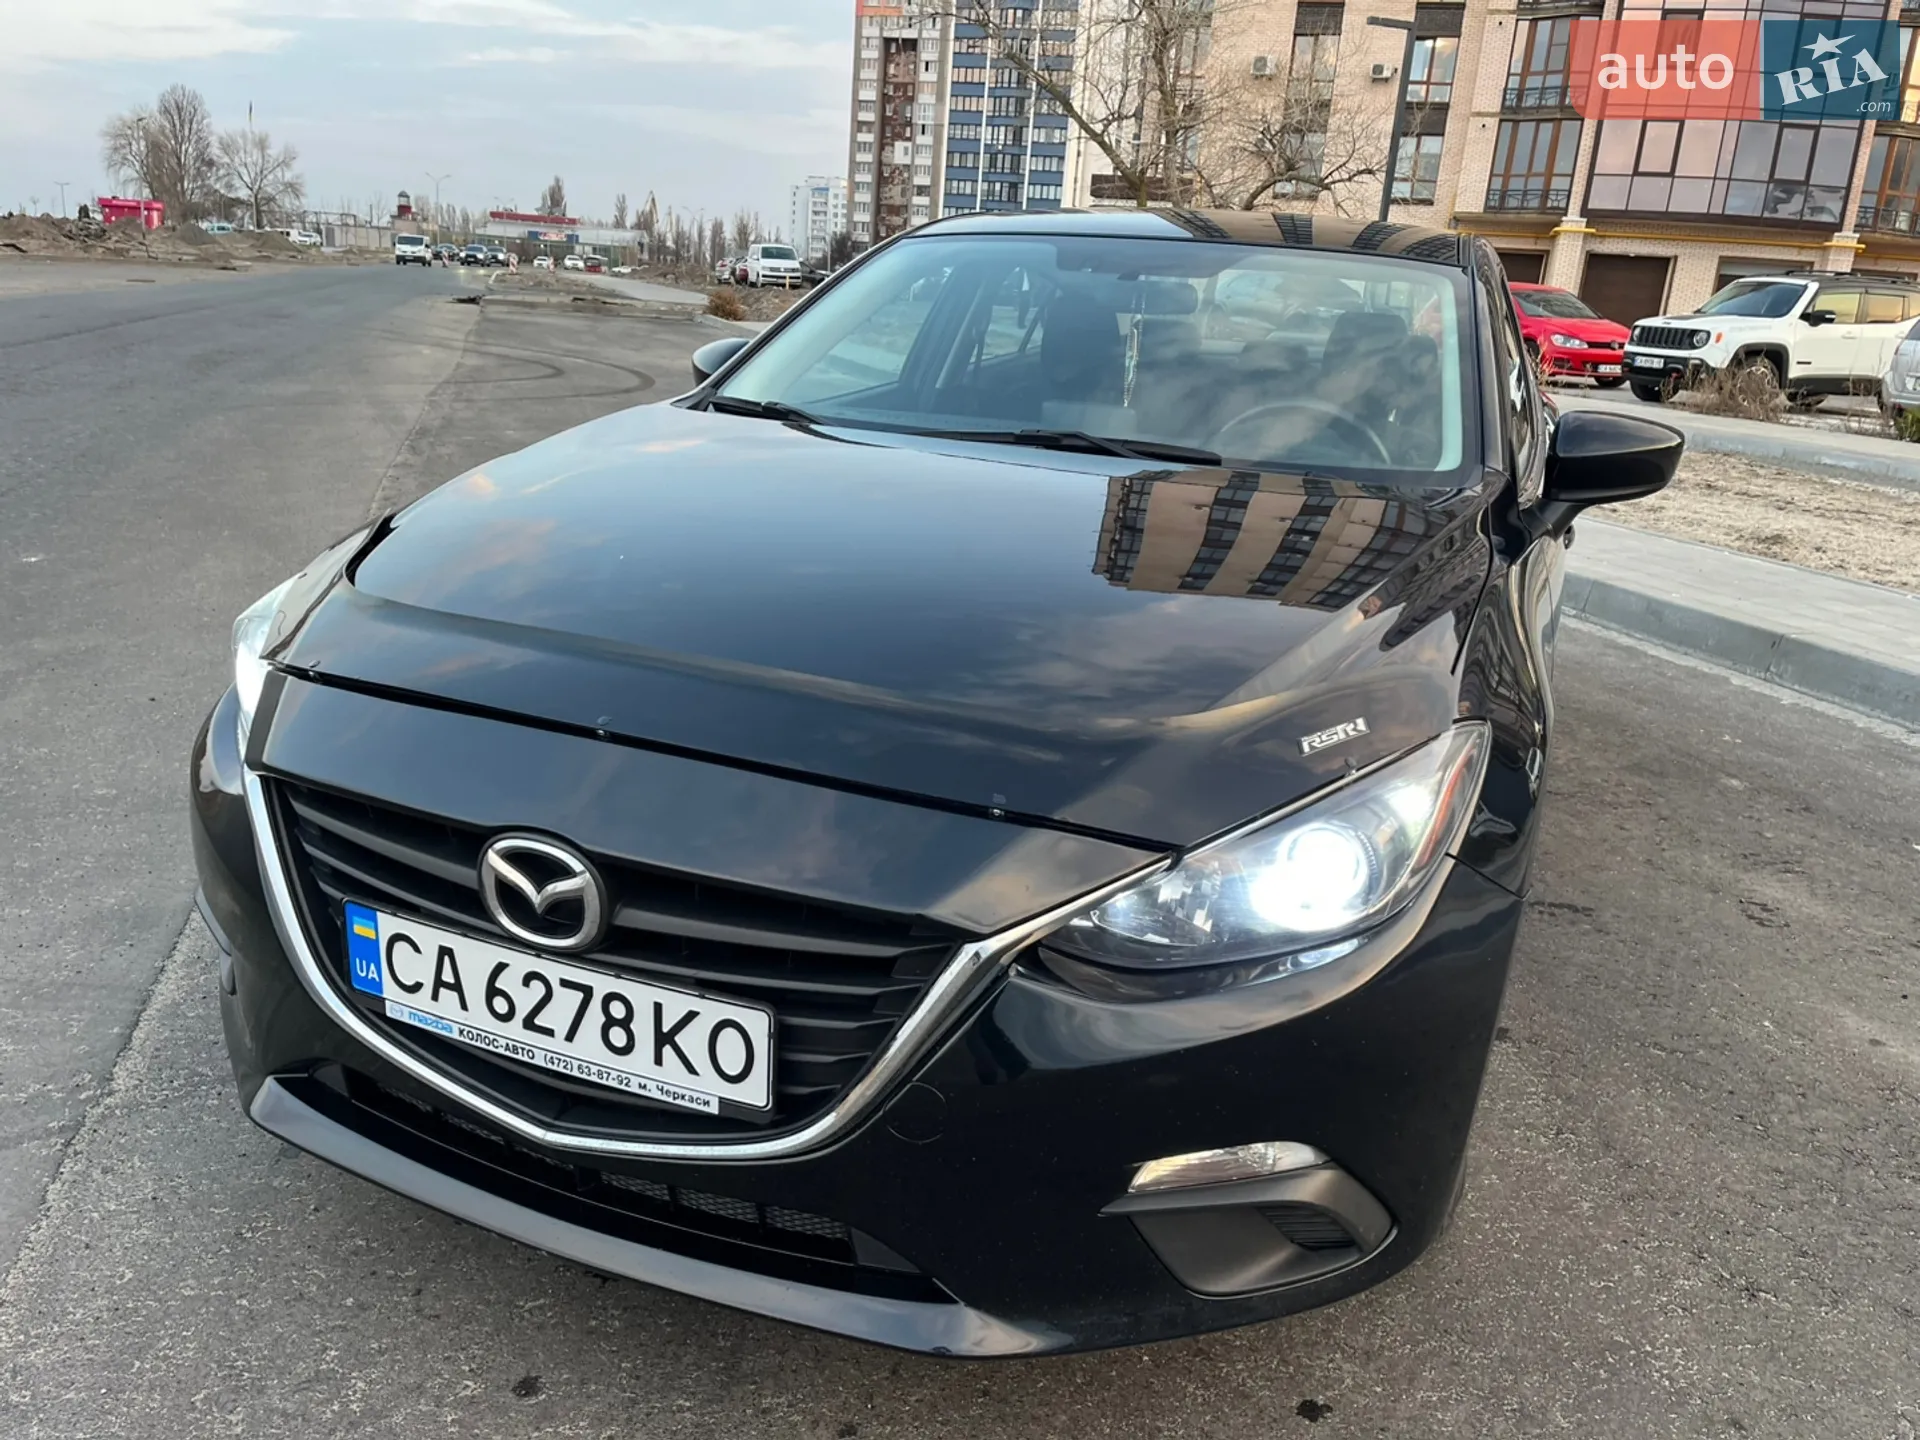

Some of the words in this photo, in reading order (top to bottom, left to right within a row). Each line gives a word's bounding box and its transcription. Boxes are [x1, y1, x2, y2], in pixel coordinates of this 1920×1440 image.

[356, 957, 379, 982] UA
[385, 931, 469, 1012] CA
[485, 961, 635, 1057] 6278
[653, 1001, 755, 1084] KO
[408, 1010, 454, 1035] mazda
[458, 1027, 535, 1060] КОЛОС-АВТО
[543, 1053, 574, 1073] (472)
[577, 1062, 632, 1088] 63-87-92
[656, 1084, 711, 1108] Черкаси
